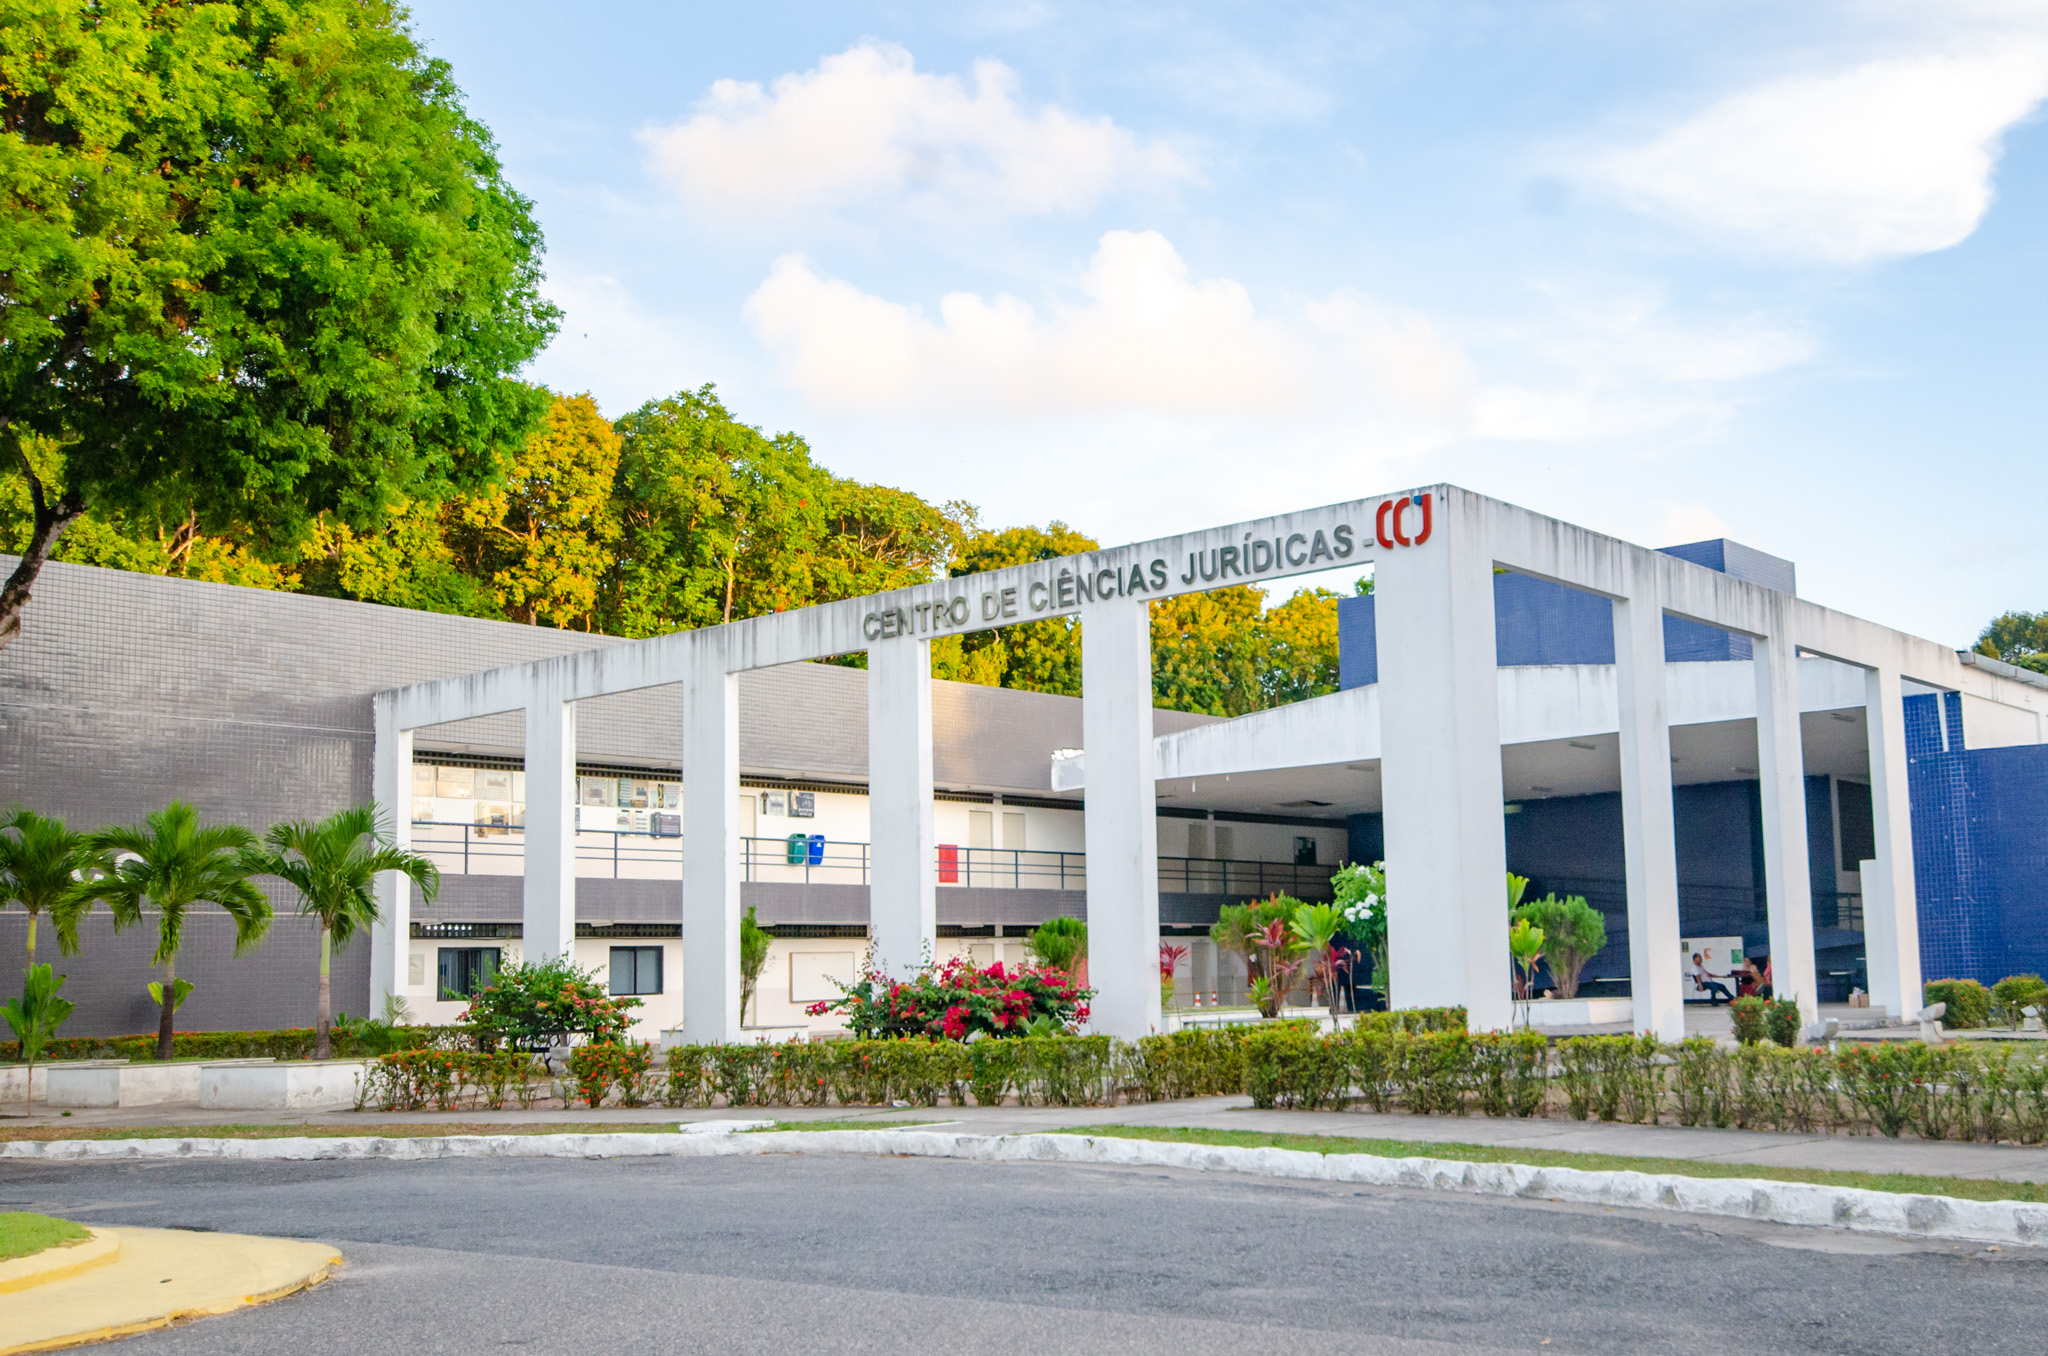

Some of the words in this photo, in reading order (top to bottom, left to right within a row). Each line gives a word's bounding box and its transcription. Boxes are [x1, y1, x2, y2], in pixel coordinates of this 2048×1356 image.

[863, 596, 970, 641] CENTRO
[982, 587, 1018, 621] DE
[1029, 559, 1168, 612] CIÊNCIAS
[1180, 524, 1355, 585] JURÍDICAS
[1376, 493, 1432, 549] CCJ
